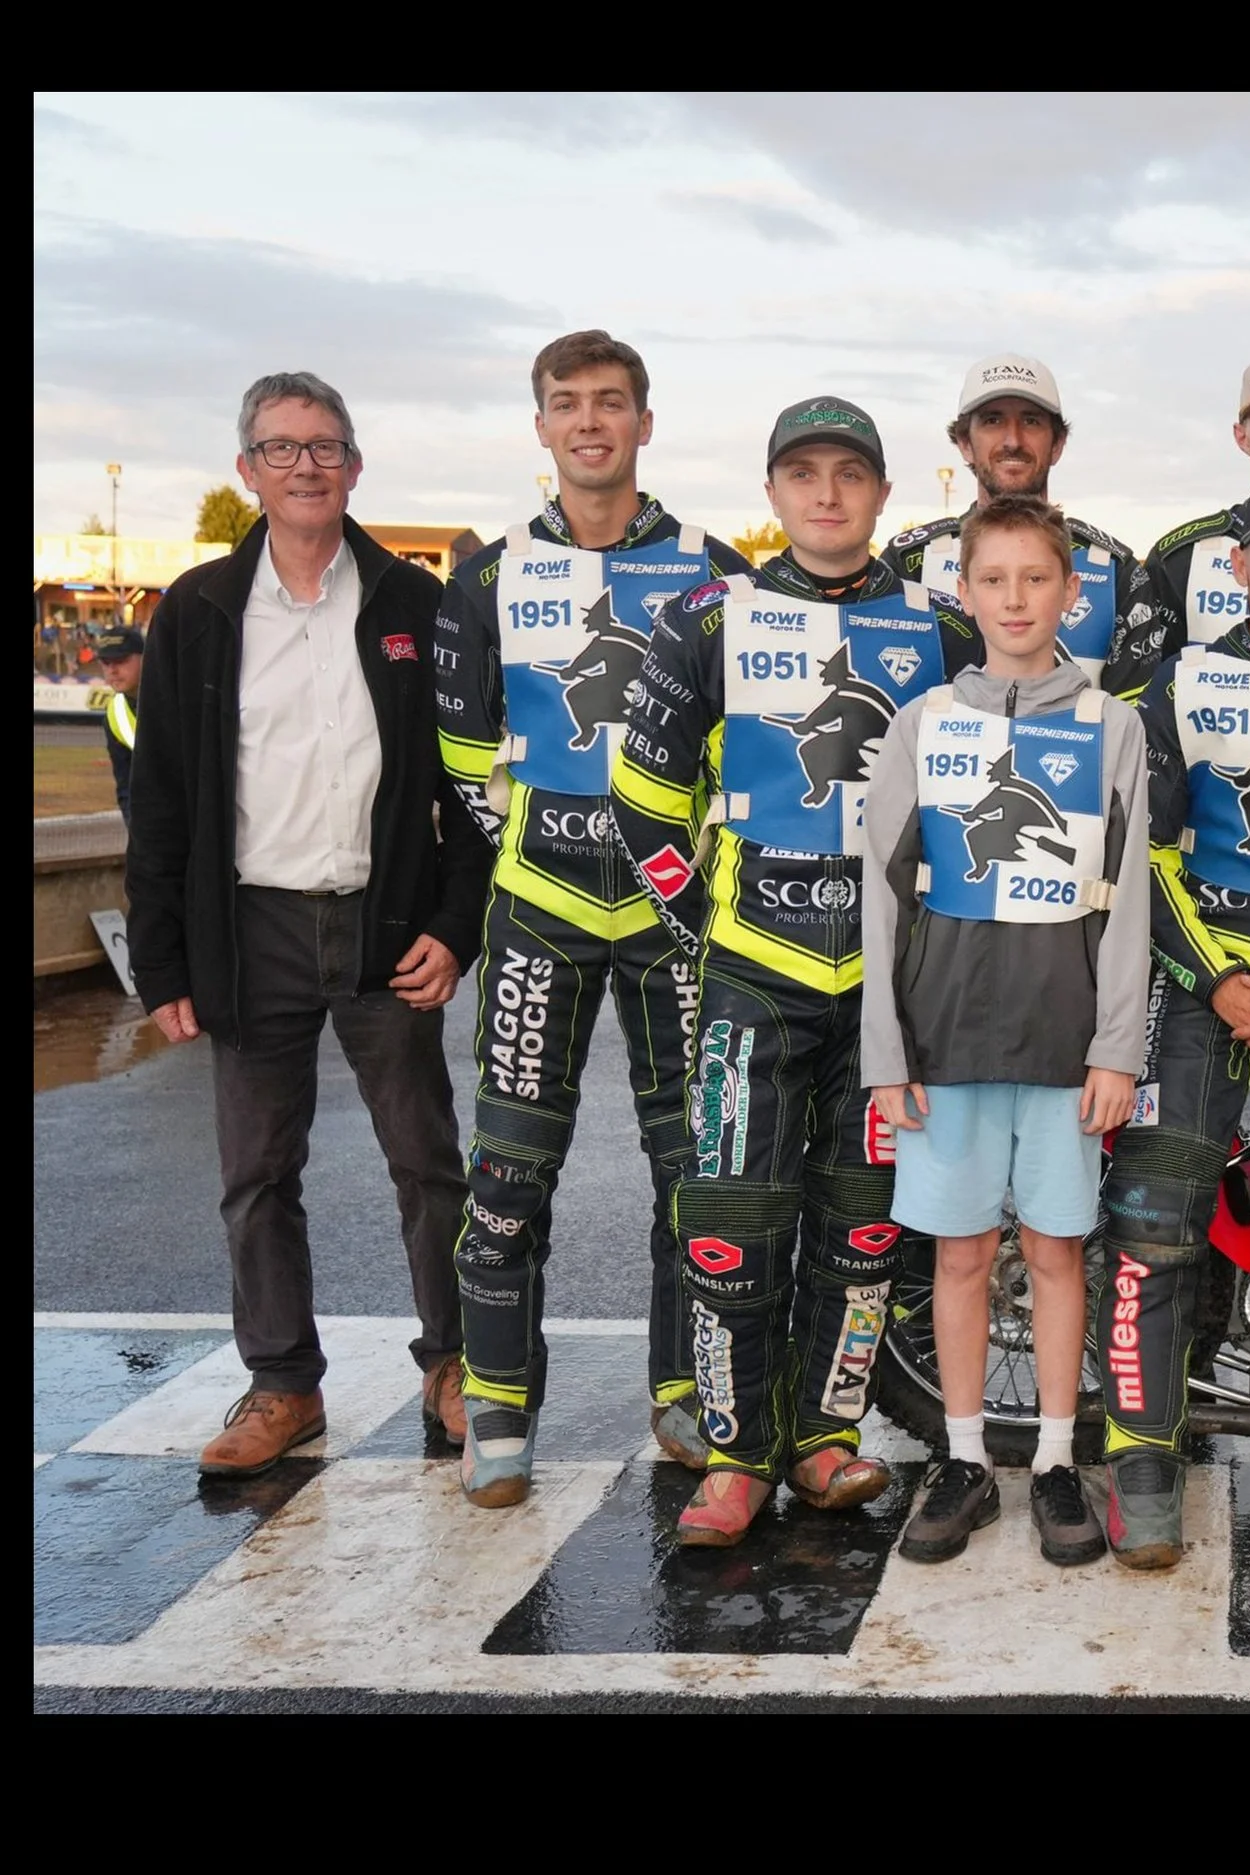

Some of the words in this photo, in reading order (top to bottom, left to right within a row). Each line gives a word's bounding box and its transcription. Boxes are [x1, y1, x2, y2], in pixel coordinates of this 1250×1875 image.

[892, 527, 929, 548] GS
[522, 559, 572, 576] ROWE
[610, 561, 700, 575] PREMIERSHIP
[943, 560, 962, 573] RO
[1212, 557, 1233, 570] RO
[508, 599, 572, 629] 1951
[929, 591, 963, 613] ROM
[750, 610, 807, 626] ROWE
[848, 614, 933, 632] PREMIERSHIP
[641, 650, 696, 705] Euston
[736, 650, 808, 681] 1951
[1197, 671, 1250, 685] ROWE
[938, 720, 984, 733] ROWE
[1014, 724, 1096, 743] PREMIERSHIP
[1186, 707, 1250, 736] 1951
[925, 753, 979, 777] 1951
[540, 808, 613, 843] SCO
[757, 876, 863, 911] SCO
[1008, 875, 1078, 905] 2026
[490, 947, 529, 1094] HAGON
[516, 956, 554, 1101] SHOCKS
[1135, 1088, 1147, 1124] FUCHS
[1109, 1251, 1151, 1412] milesey
[716, 1328, 728, 1405] SOLUTIONS
